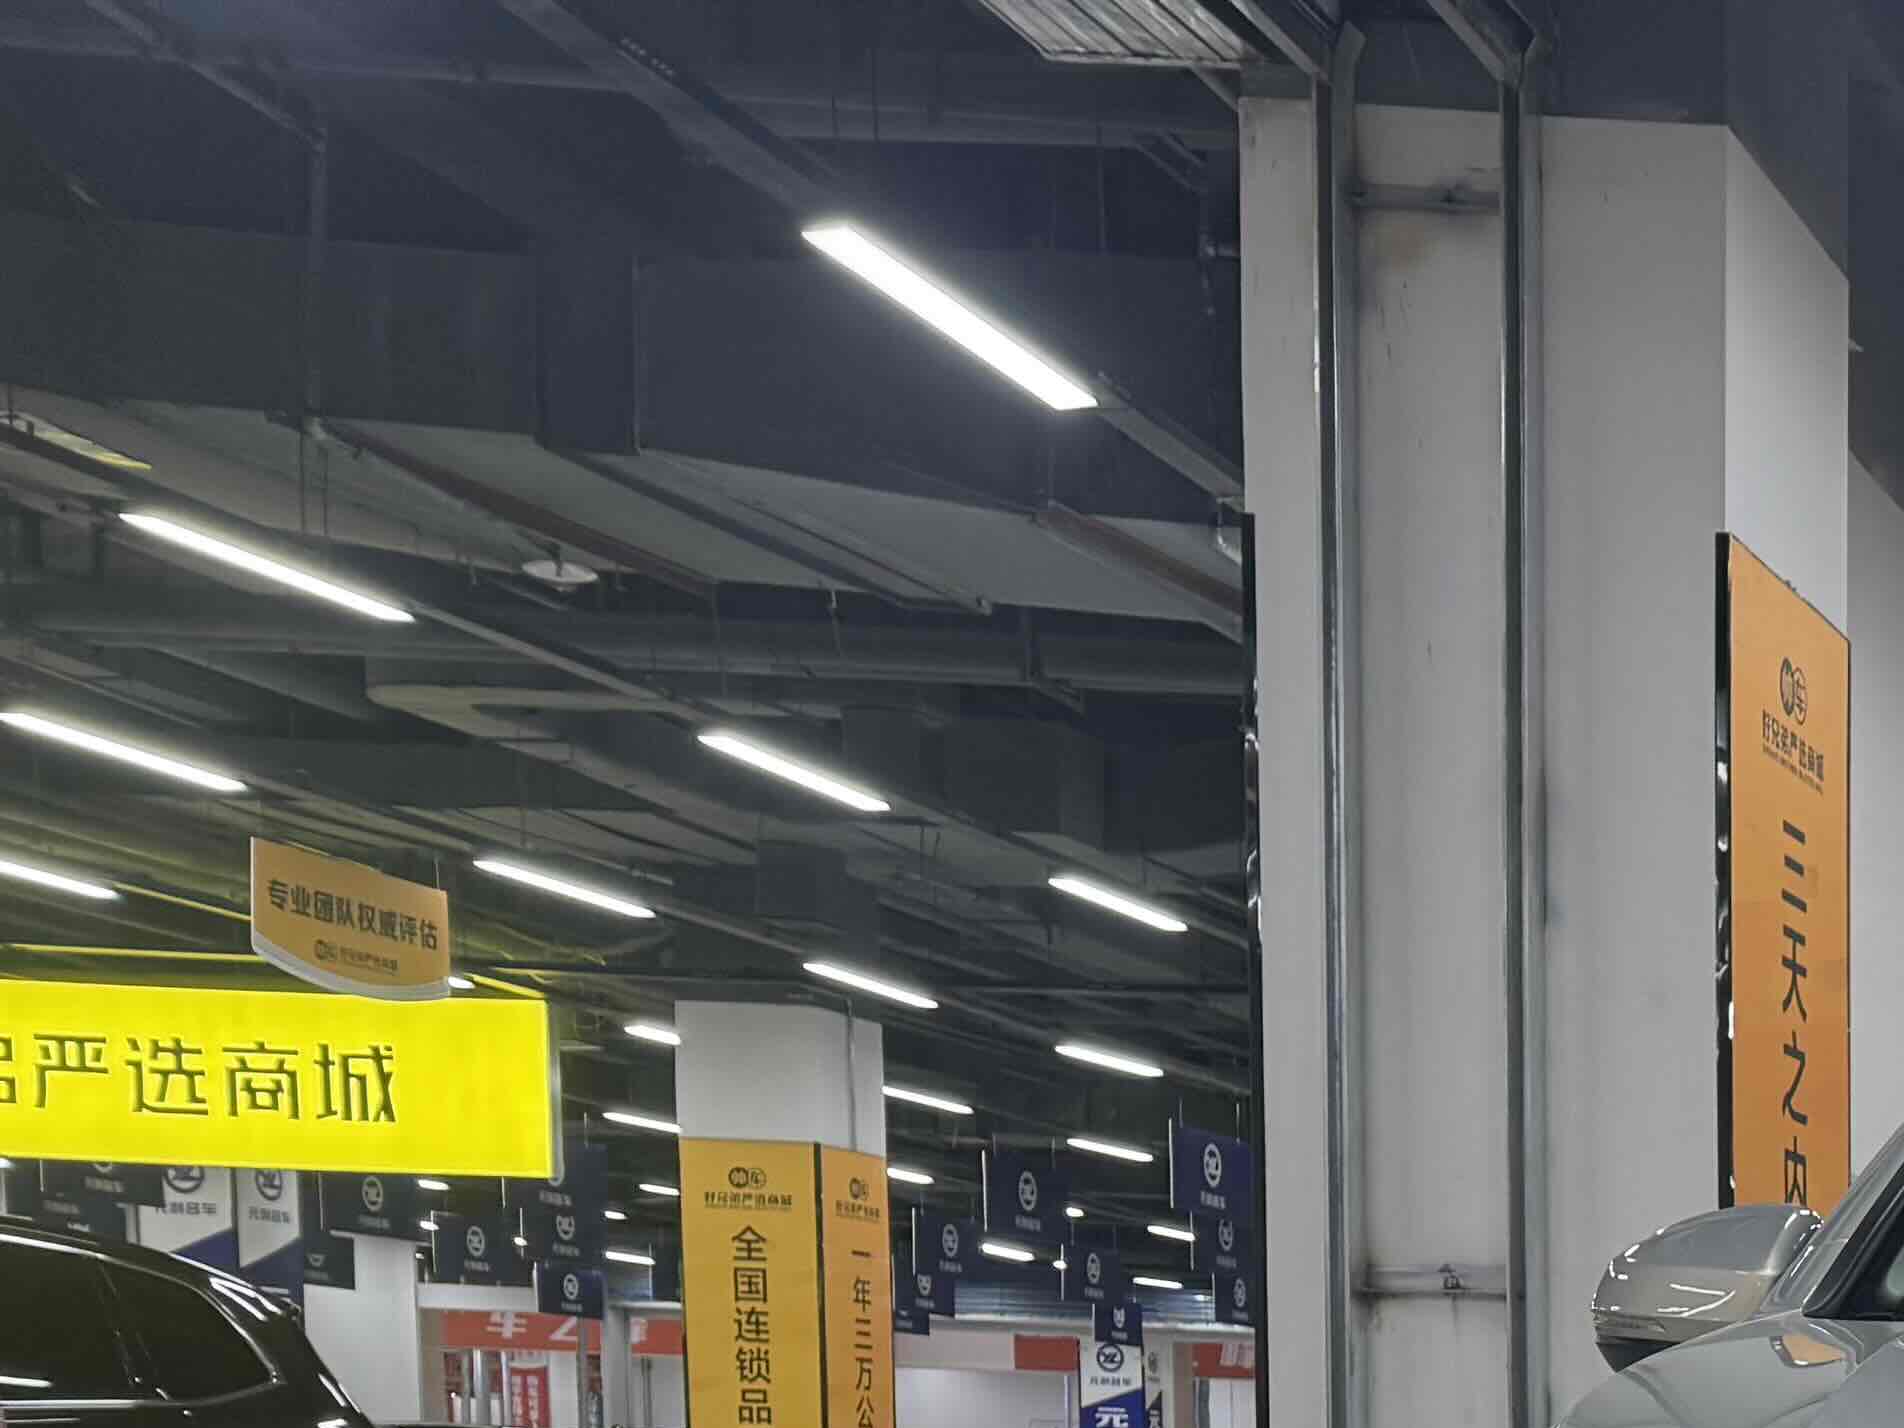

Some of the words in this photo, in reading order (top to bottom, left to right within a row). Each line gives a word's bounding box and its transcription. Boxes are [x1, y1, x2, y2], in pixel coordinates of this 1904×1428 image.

[267, 879, 438, 951] 专业团队权威评估
[1781, 819, 1808, 1206] 三天之内
